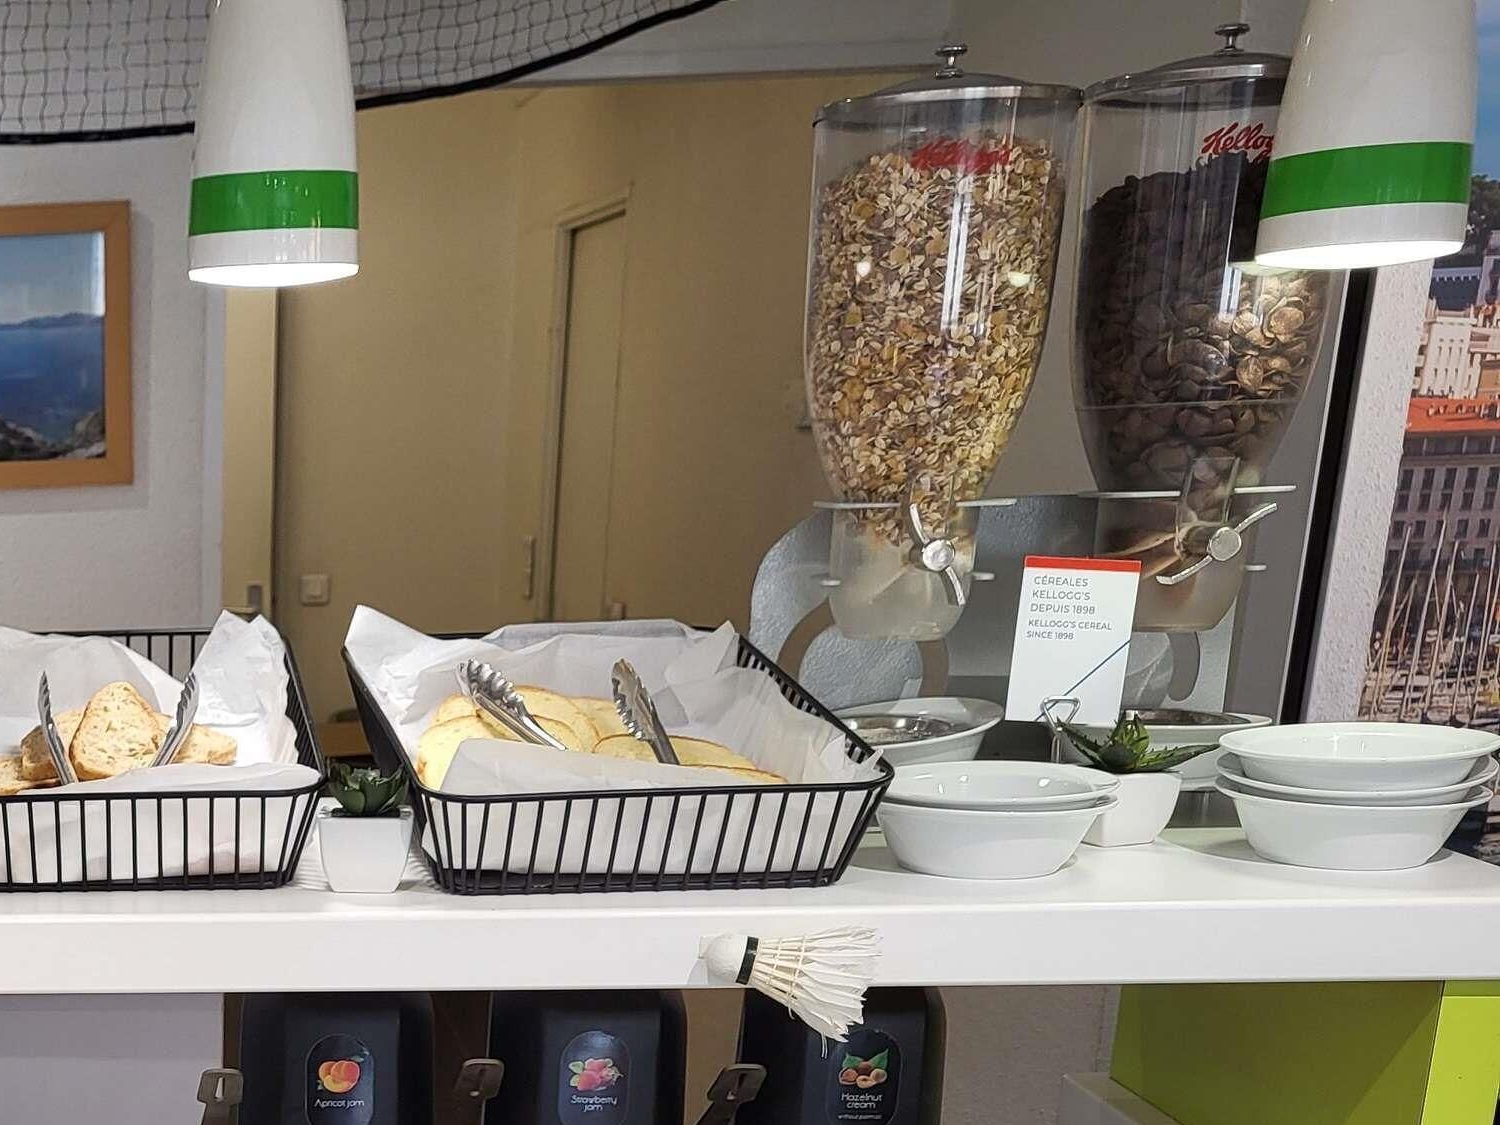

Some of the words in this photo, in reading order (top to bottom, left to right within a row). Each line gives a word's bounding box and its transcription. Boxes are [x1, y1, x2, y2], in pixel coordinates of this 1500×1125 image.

[1032, 590, 1091, 601] KELLOGG'S
[1030, 603, 1070, 614] DEPUIS
[1072, 604, 1095, 615] 1898
[1028, 620, 1076, 629] KELLOGG'S
[1078, 621, 1112, 631] CEREAL
[1026, 631, 1052, 640] SINCE
[1055, 631, 1074, 640] 1898
